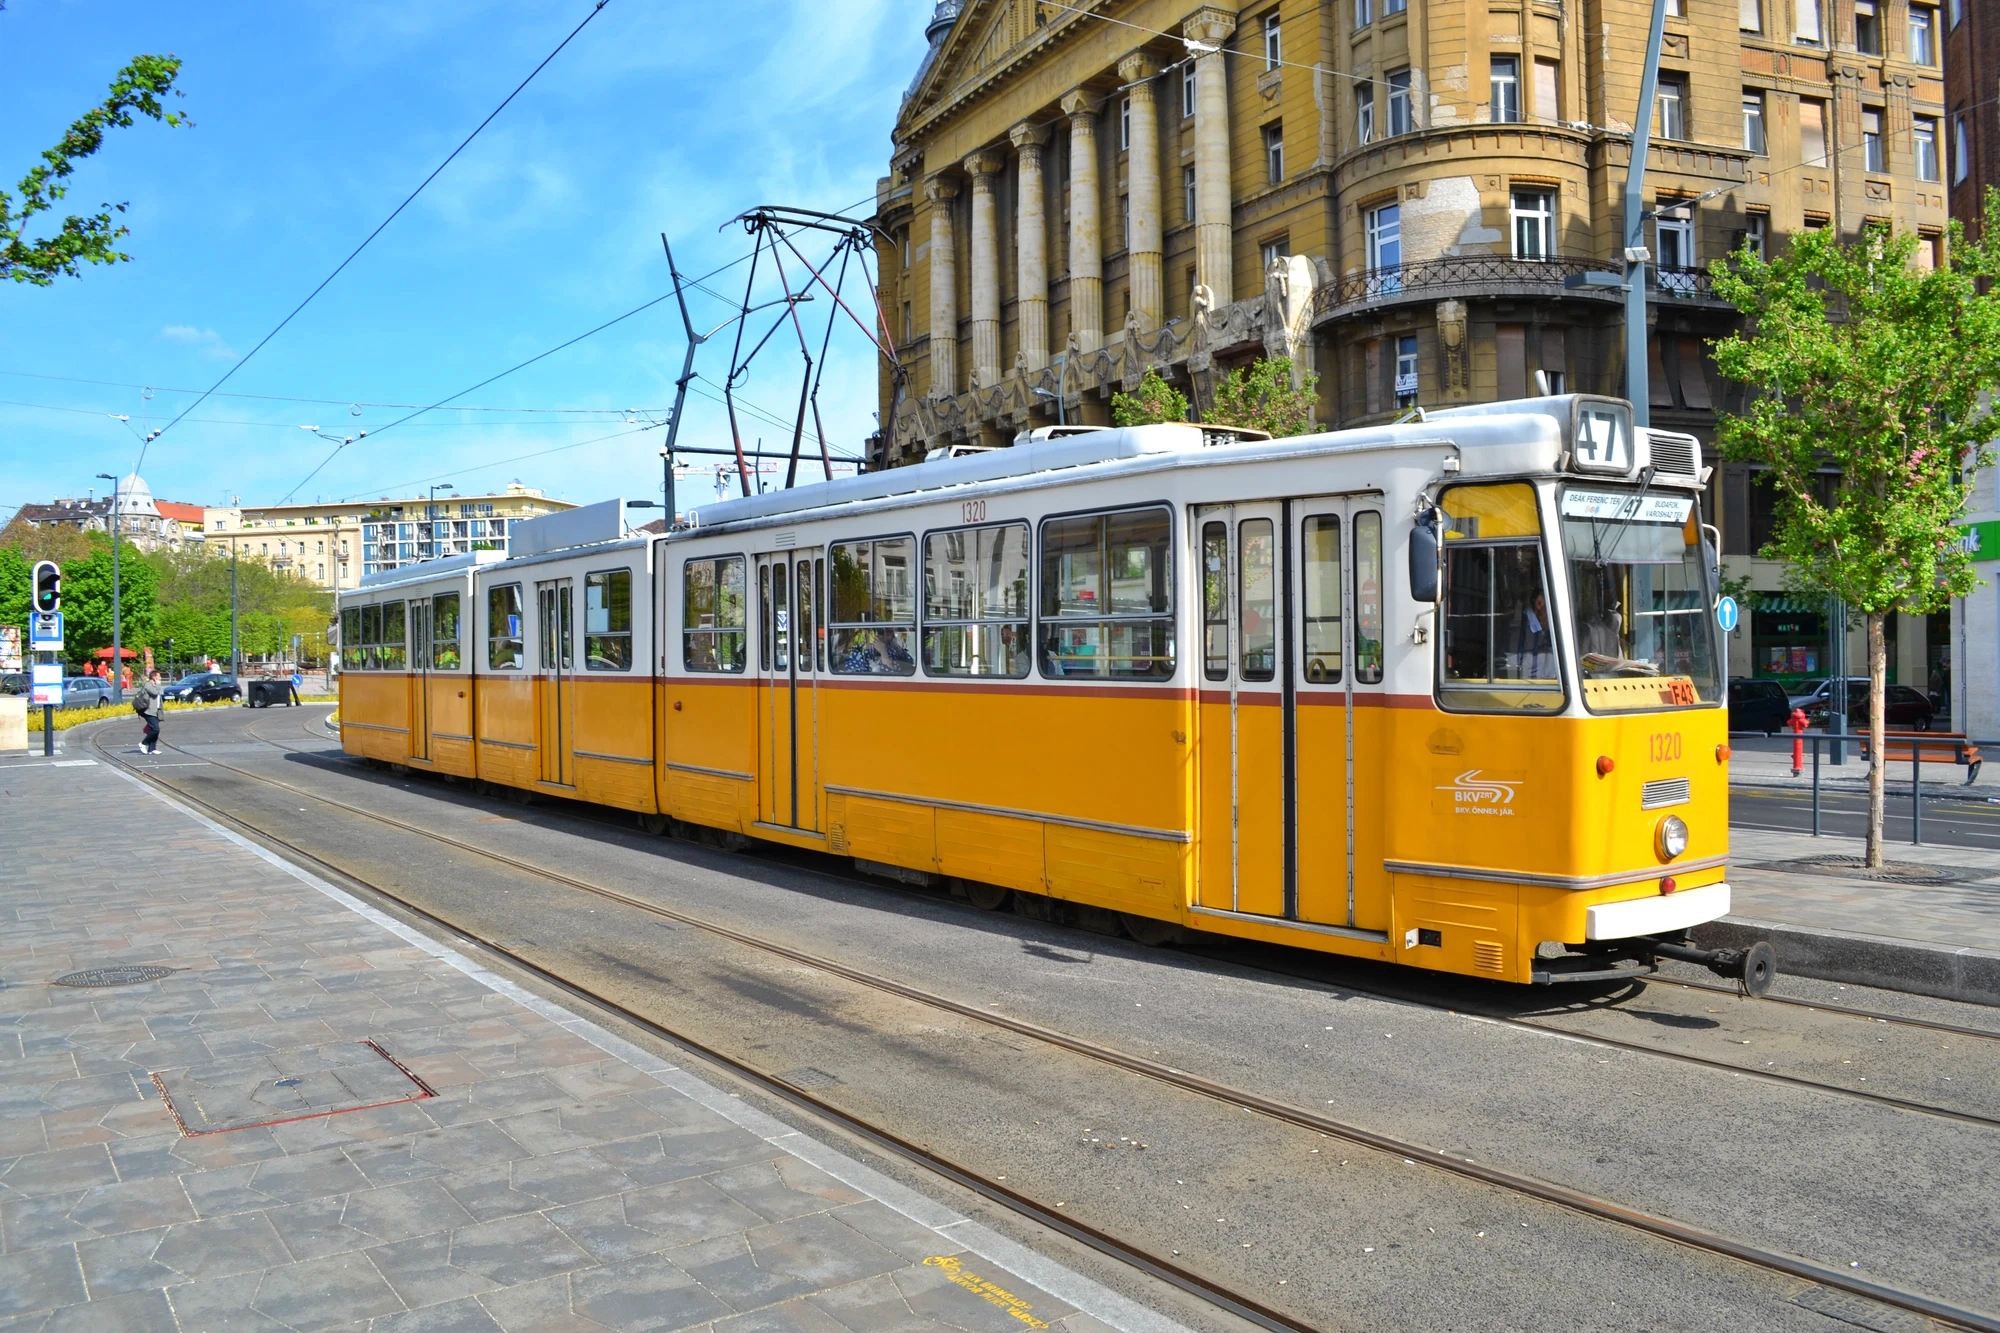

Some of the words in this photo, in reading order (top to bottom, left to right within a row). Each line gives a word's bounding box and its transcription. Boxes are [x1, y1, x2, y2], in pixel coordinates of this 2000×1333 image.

[1577, 410, 1617, 462] 47
[1570, 494, 1585, 503] DEÁK
[1586, 496, 1609, 505] FERENC
[1609, 497, 1620, 506] TÉR
[1624, 499, 1643, 517] 47
[962, 499, 986, 524] 1320
[1672, 684, 1694, 705] F43
[1649, 731, 1682, 763] 1320
[1455, 791, 1480, 803] BKV
[1480, 791, 1493, 799] ZRT
[1472, 806, 1498, 815] ÖNNEK
